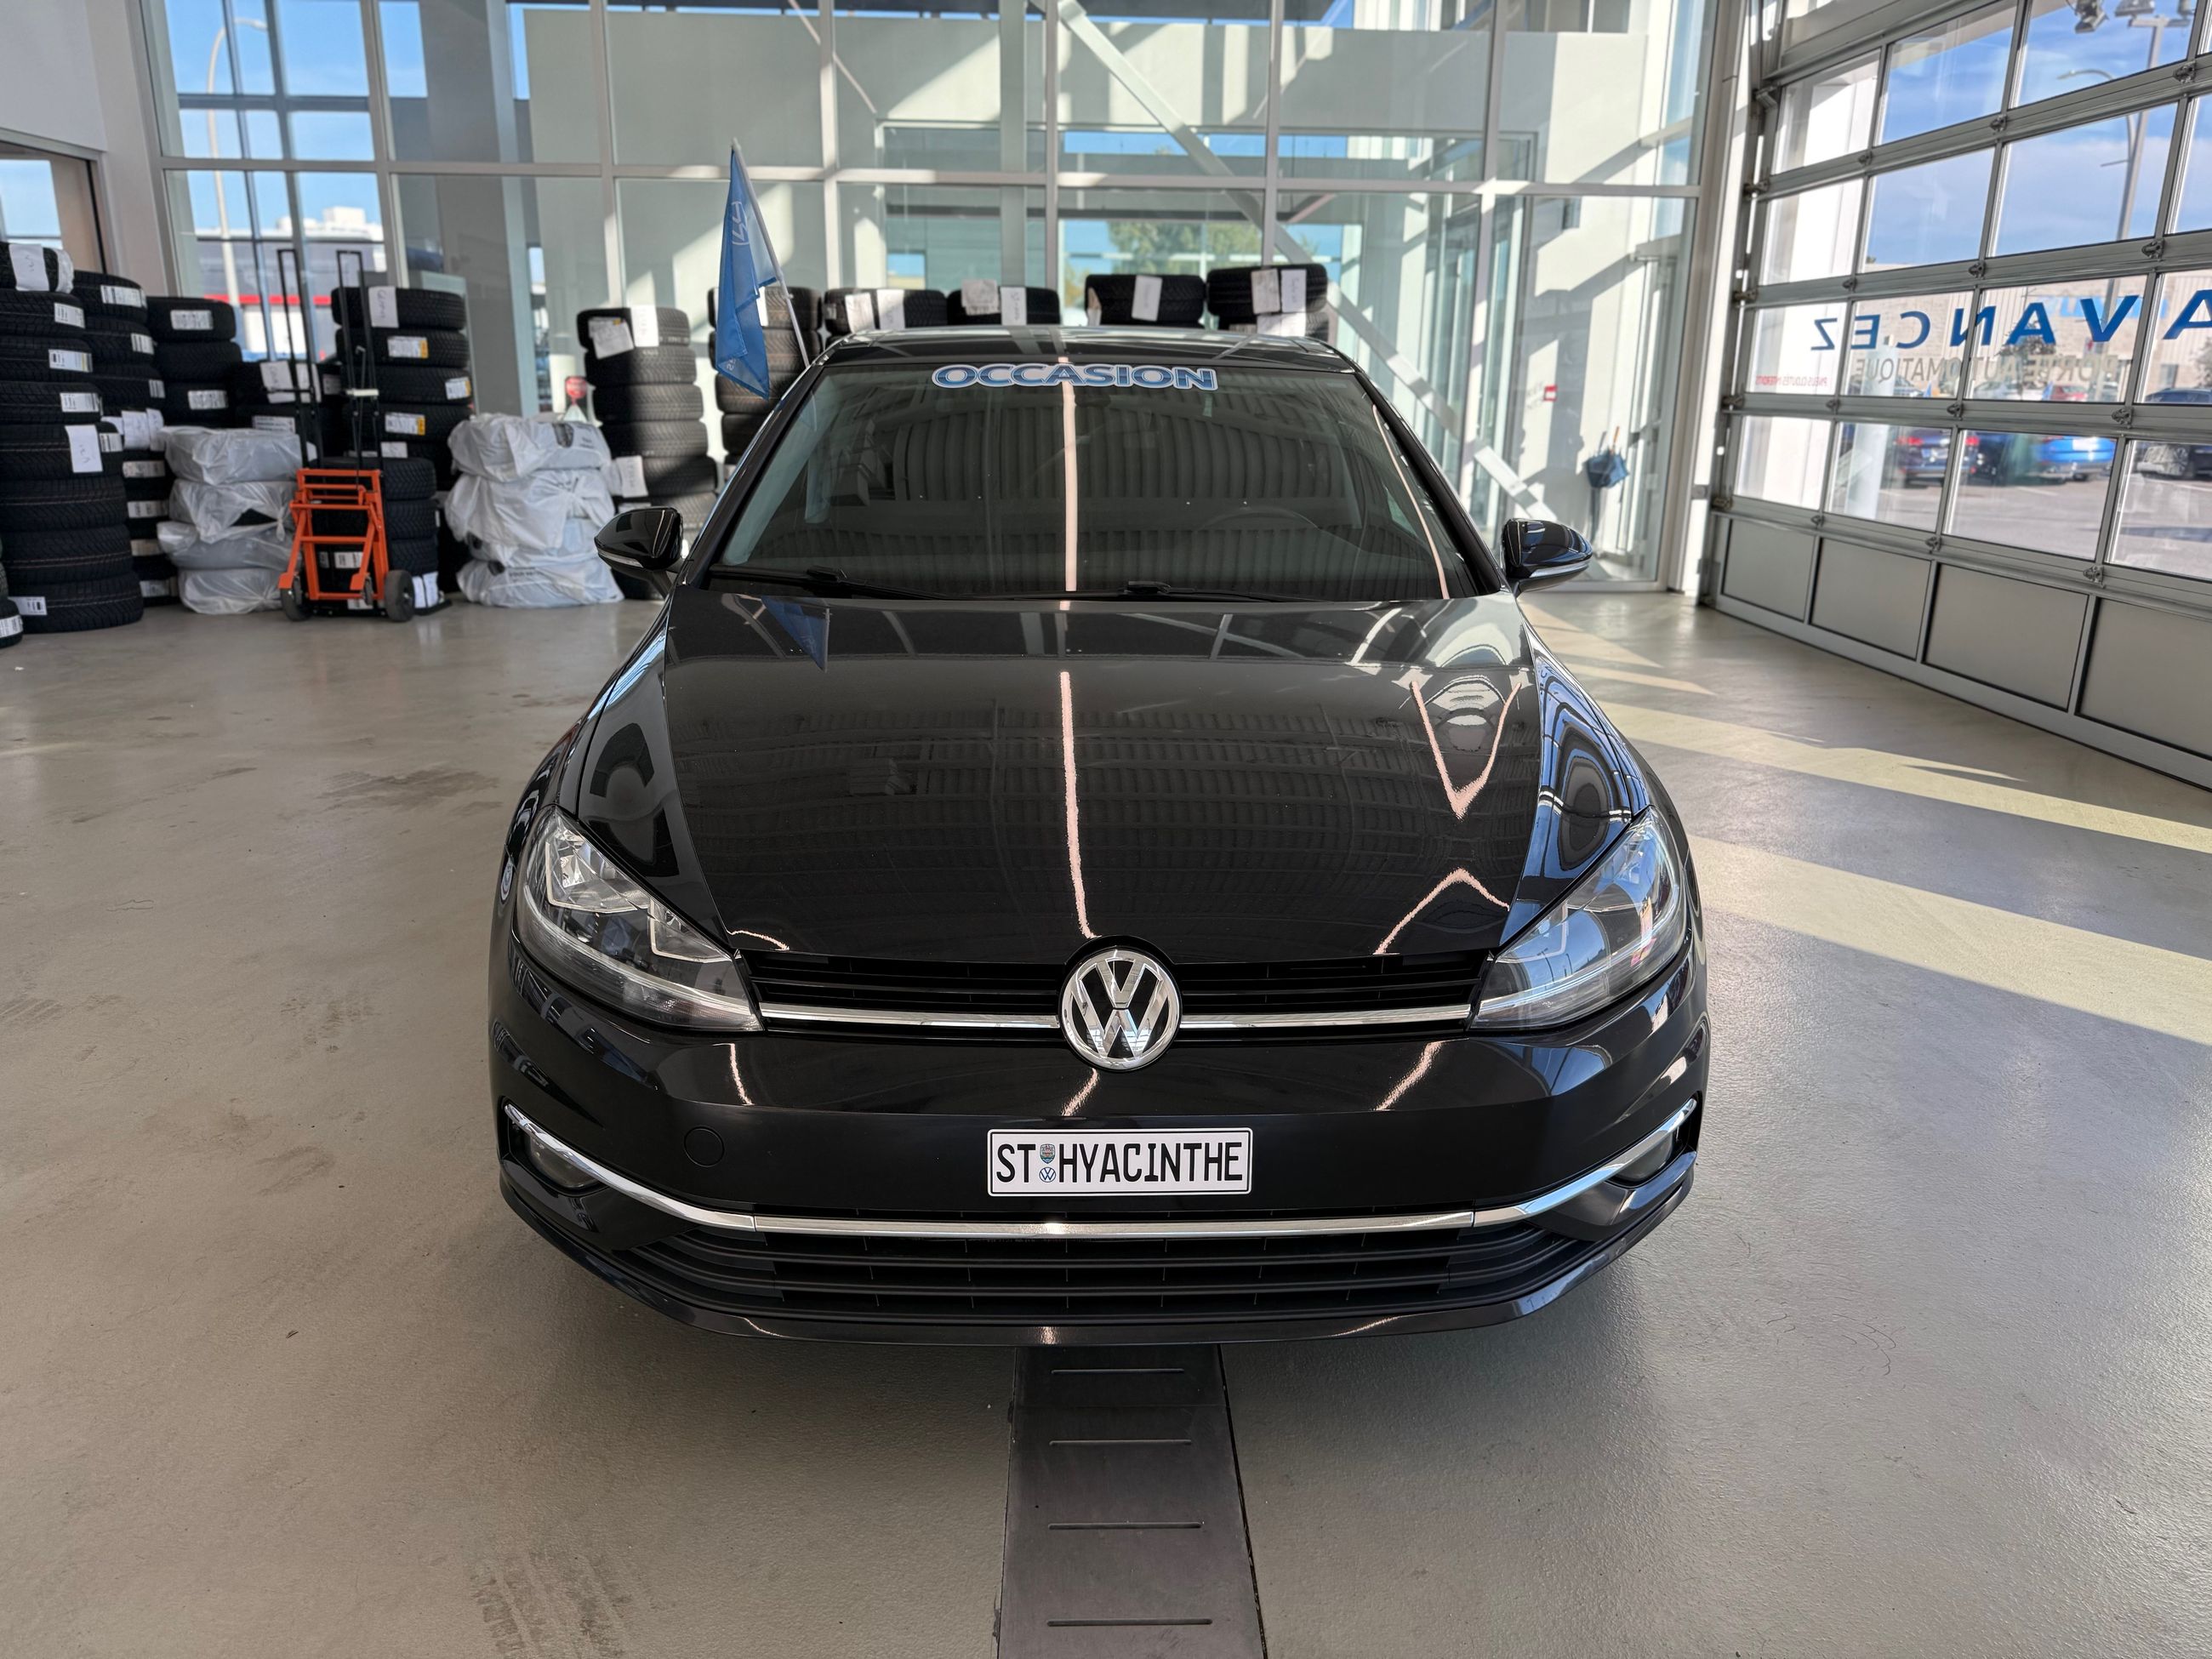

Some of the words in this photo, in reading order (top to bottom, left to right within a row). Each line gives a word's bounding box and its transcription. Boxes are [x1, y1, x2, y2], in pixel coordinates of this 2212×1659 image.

[932, 363, 1218, 391] OCCASION
[996, 1143, 1036, 1183] ST
[1059, 1142, 1243, 1183] HYACINTHE
